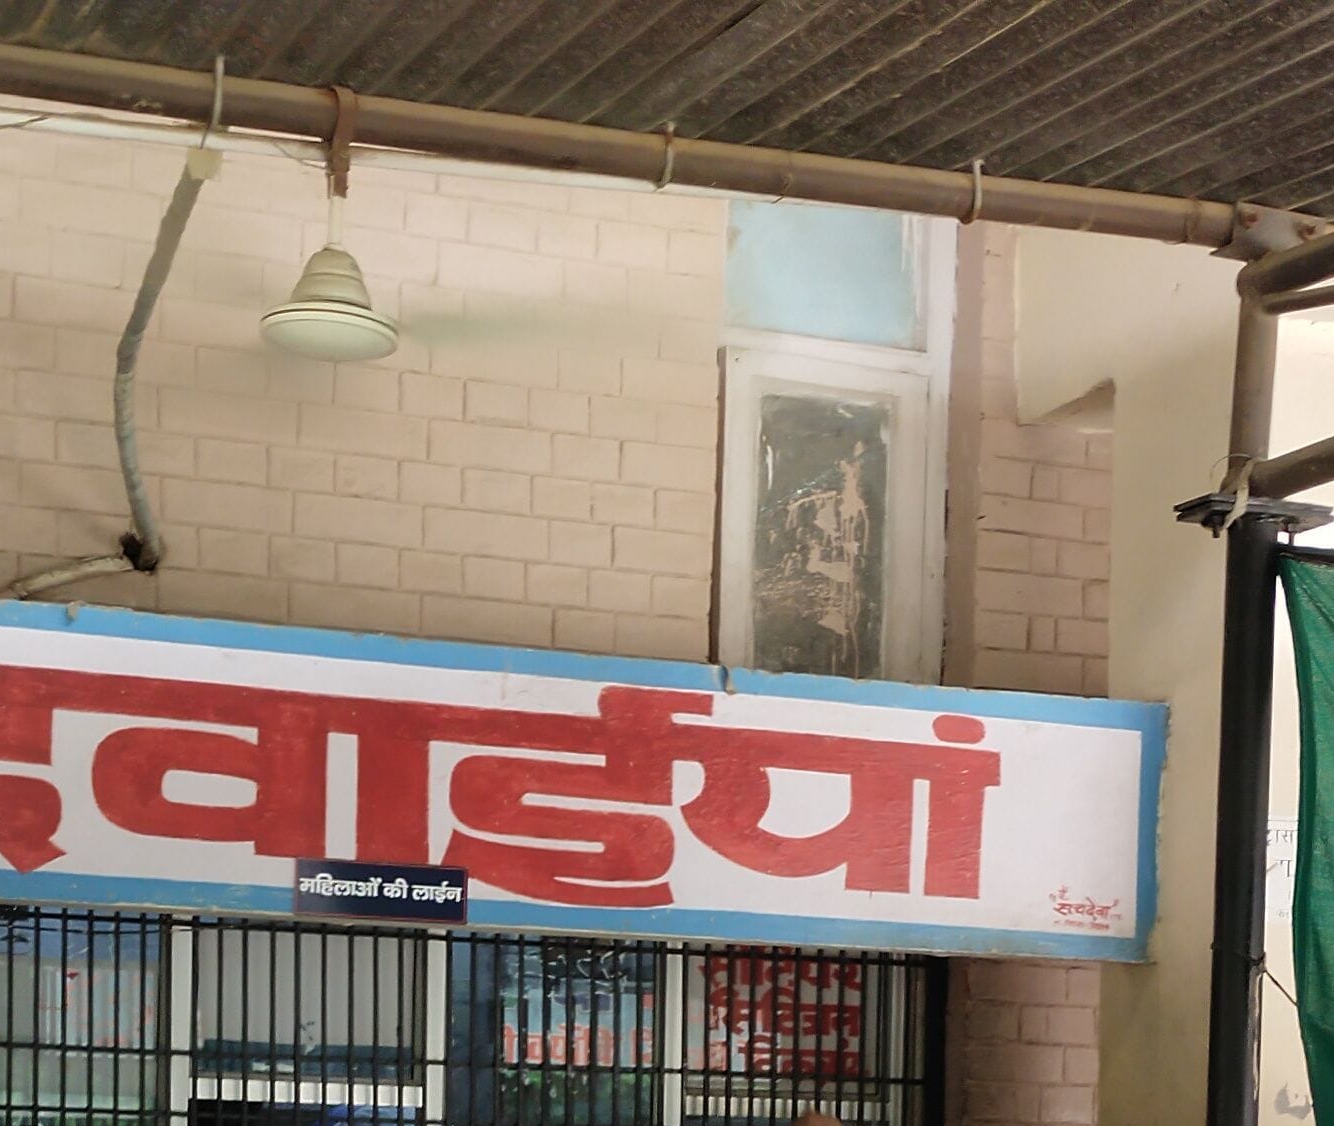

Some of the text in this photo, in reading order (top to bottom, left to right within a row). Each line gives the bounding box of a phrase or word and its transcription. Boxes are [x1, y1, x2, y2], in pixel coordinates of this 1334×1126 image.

[299, 872, 463, 904] महिलाओं की लाईन
